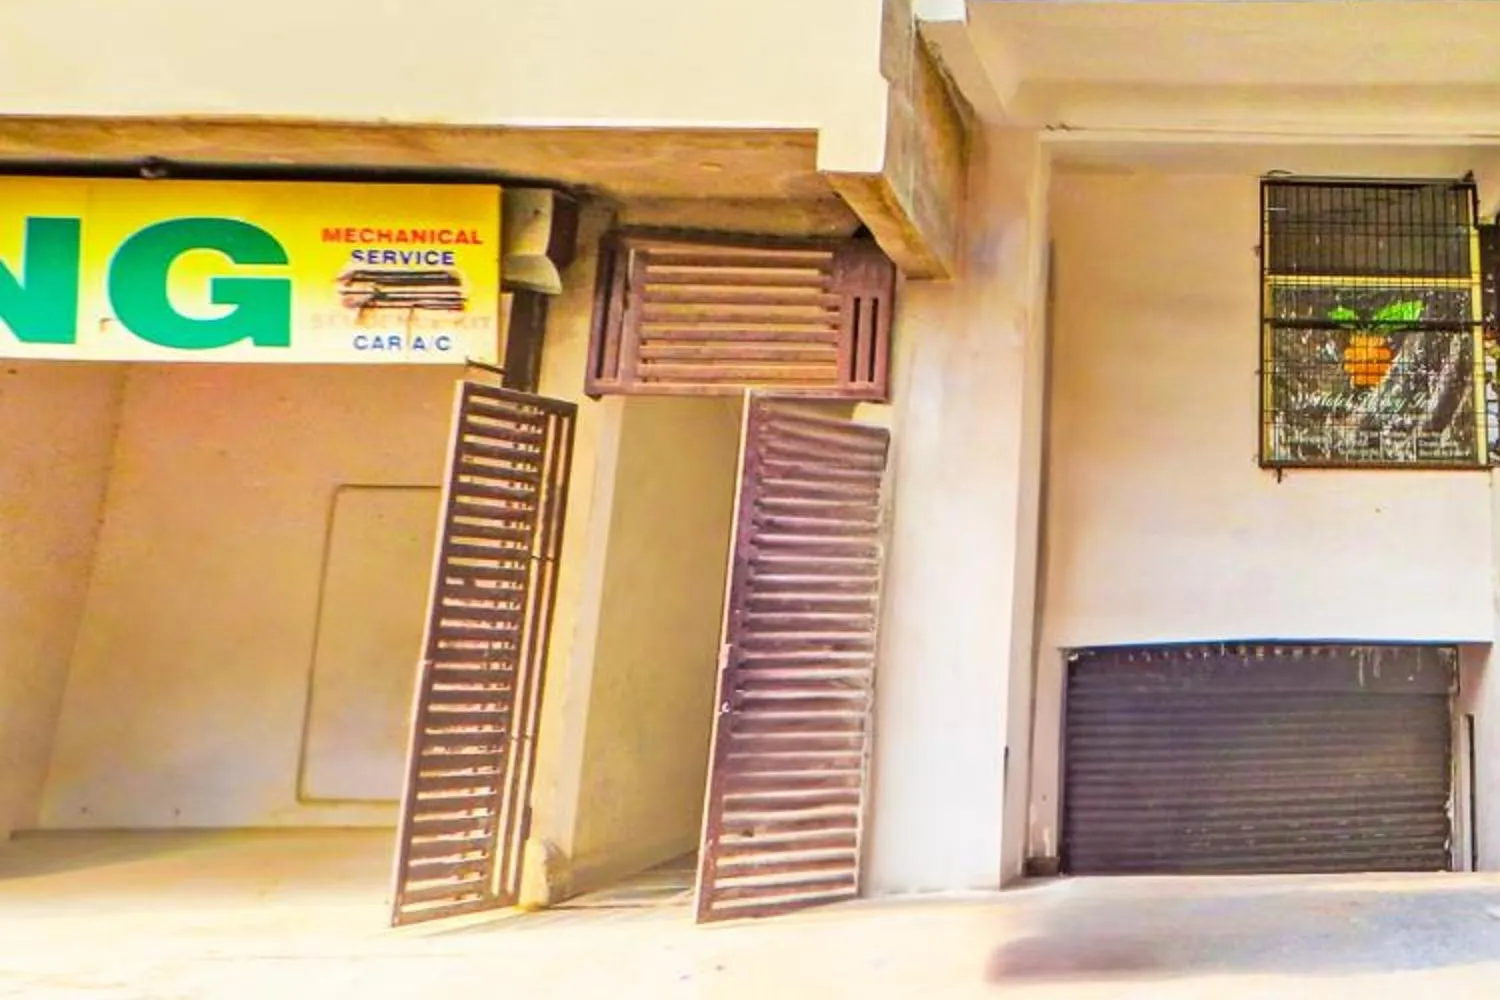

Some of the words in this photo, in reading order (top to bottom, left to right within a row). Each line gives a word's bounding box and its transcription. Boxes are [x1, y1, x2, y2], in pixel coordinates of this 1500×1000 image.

[321, 228, 483, 245] MECHANICAL
[351, 249, 456, 265] SERVICE
[353, 335, 401, 351] CAR
